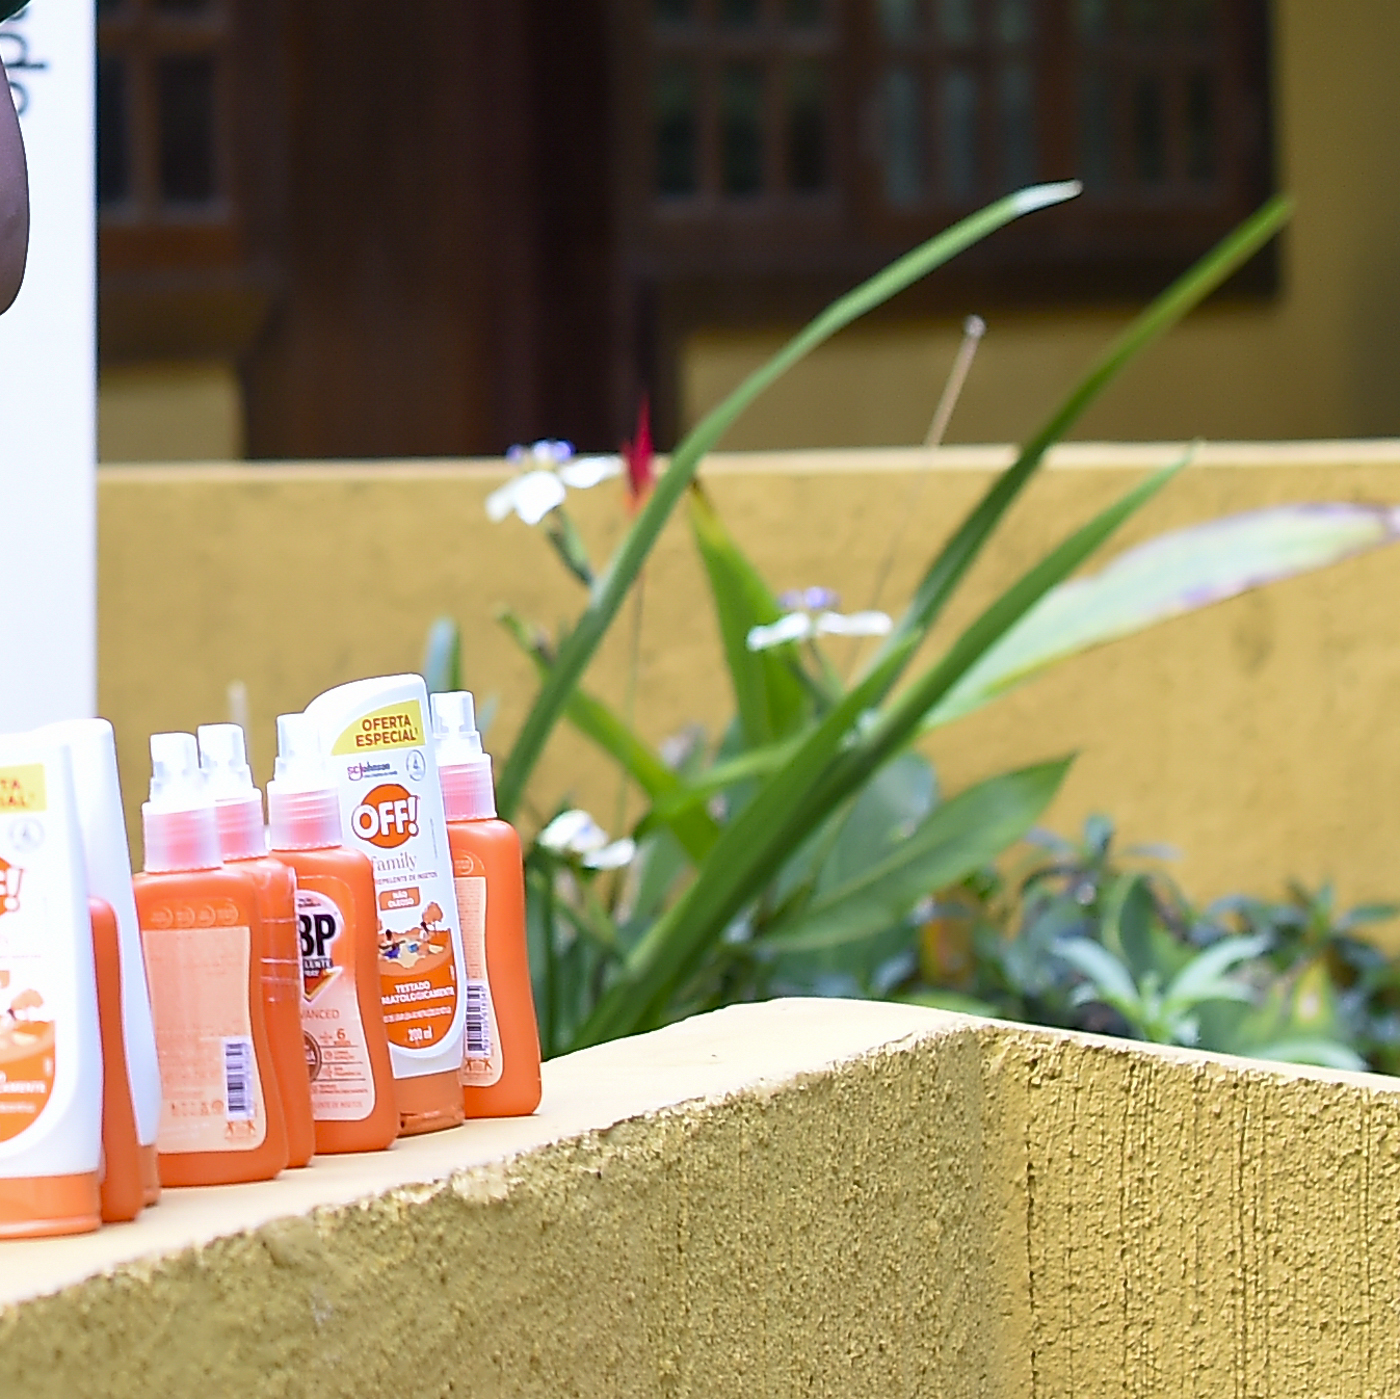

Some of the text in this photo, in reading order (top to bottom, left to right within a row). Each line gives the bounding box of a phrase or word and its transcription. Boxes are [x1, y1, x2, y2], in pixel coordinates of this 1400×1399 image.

[362, 714, 412, 732] OFERTA
[351, 794, 419, 842] OFF!
[371, 851, 417, 872] family
[298, 914, 336, 956] BP
[300, 1009, 340, 1020] VANCED
